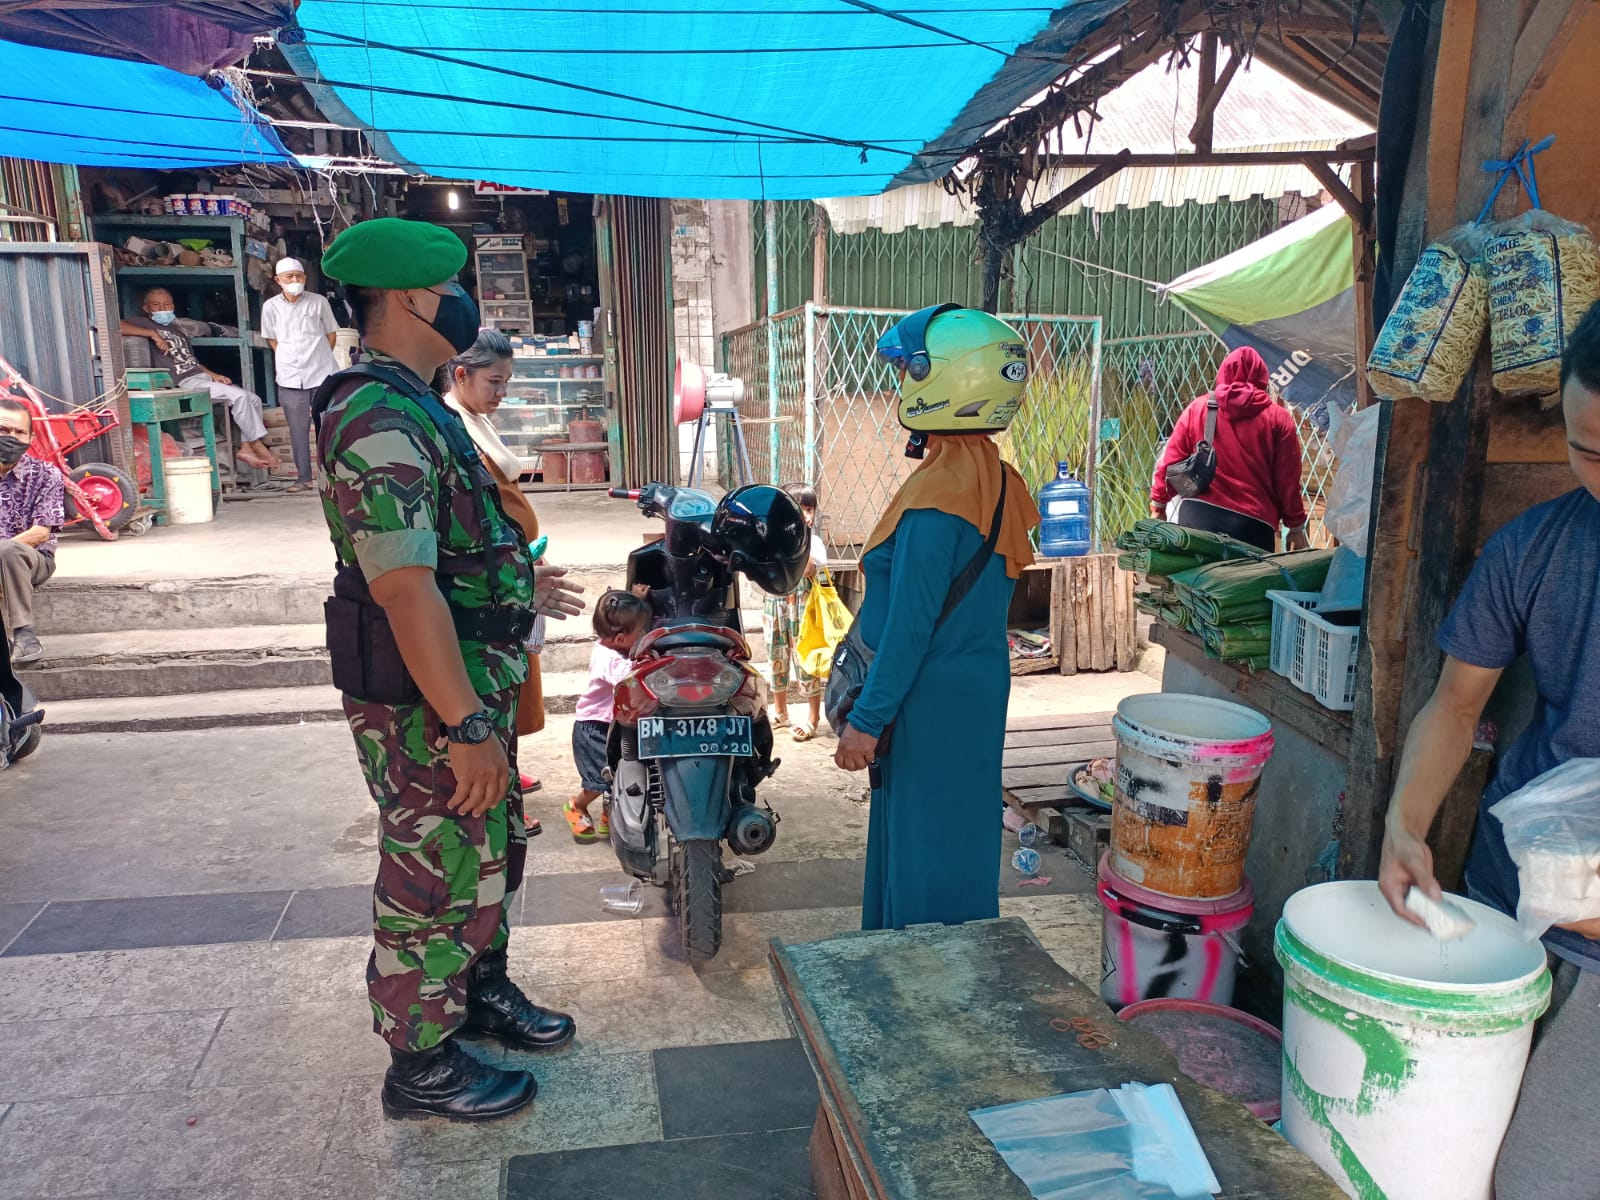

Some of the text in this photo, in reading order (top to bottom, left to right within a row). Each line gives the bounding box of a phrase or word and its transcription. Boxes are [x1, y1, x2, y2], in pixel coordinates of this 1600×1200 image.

[641, 717, 745, 738] BM 3148 JY
